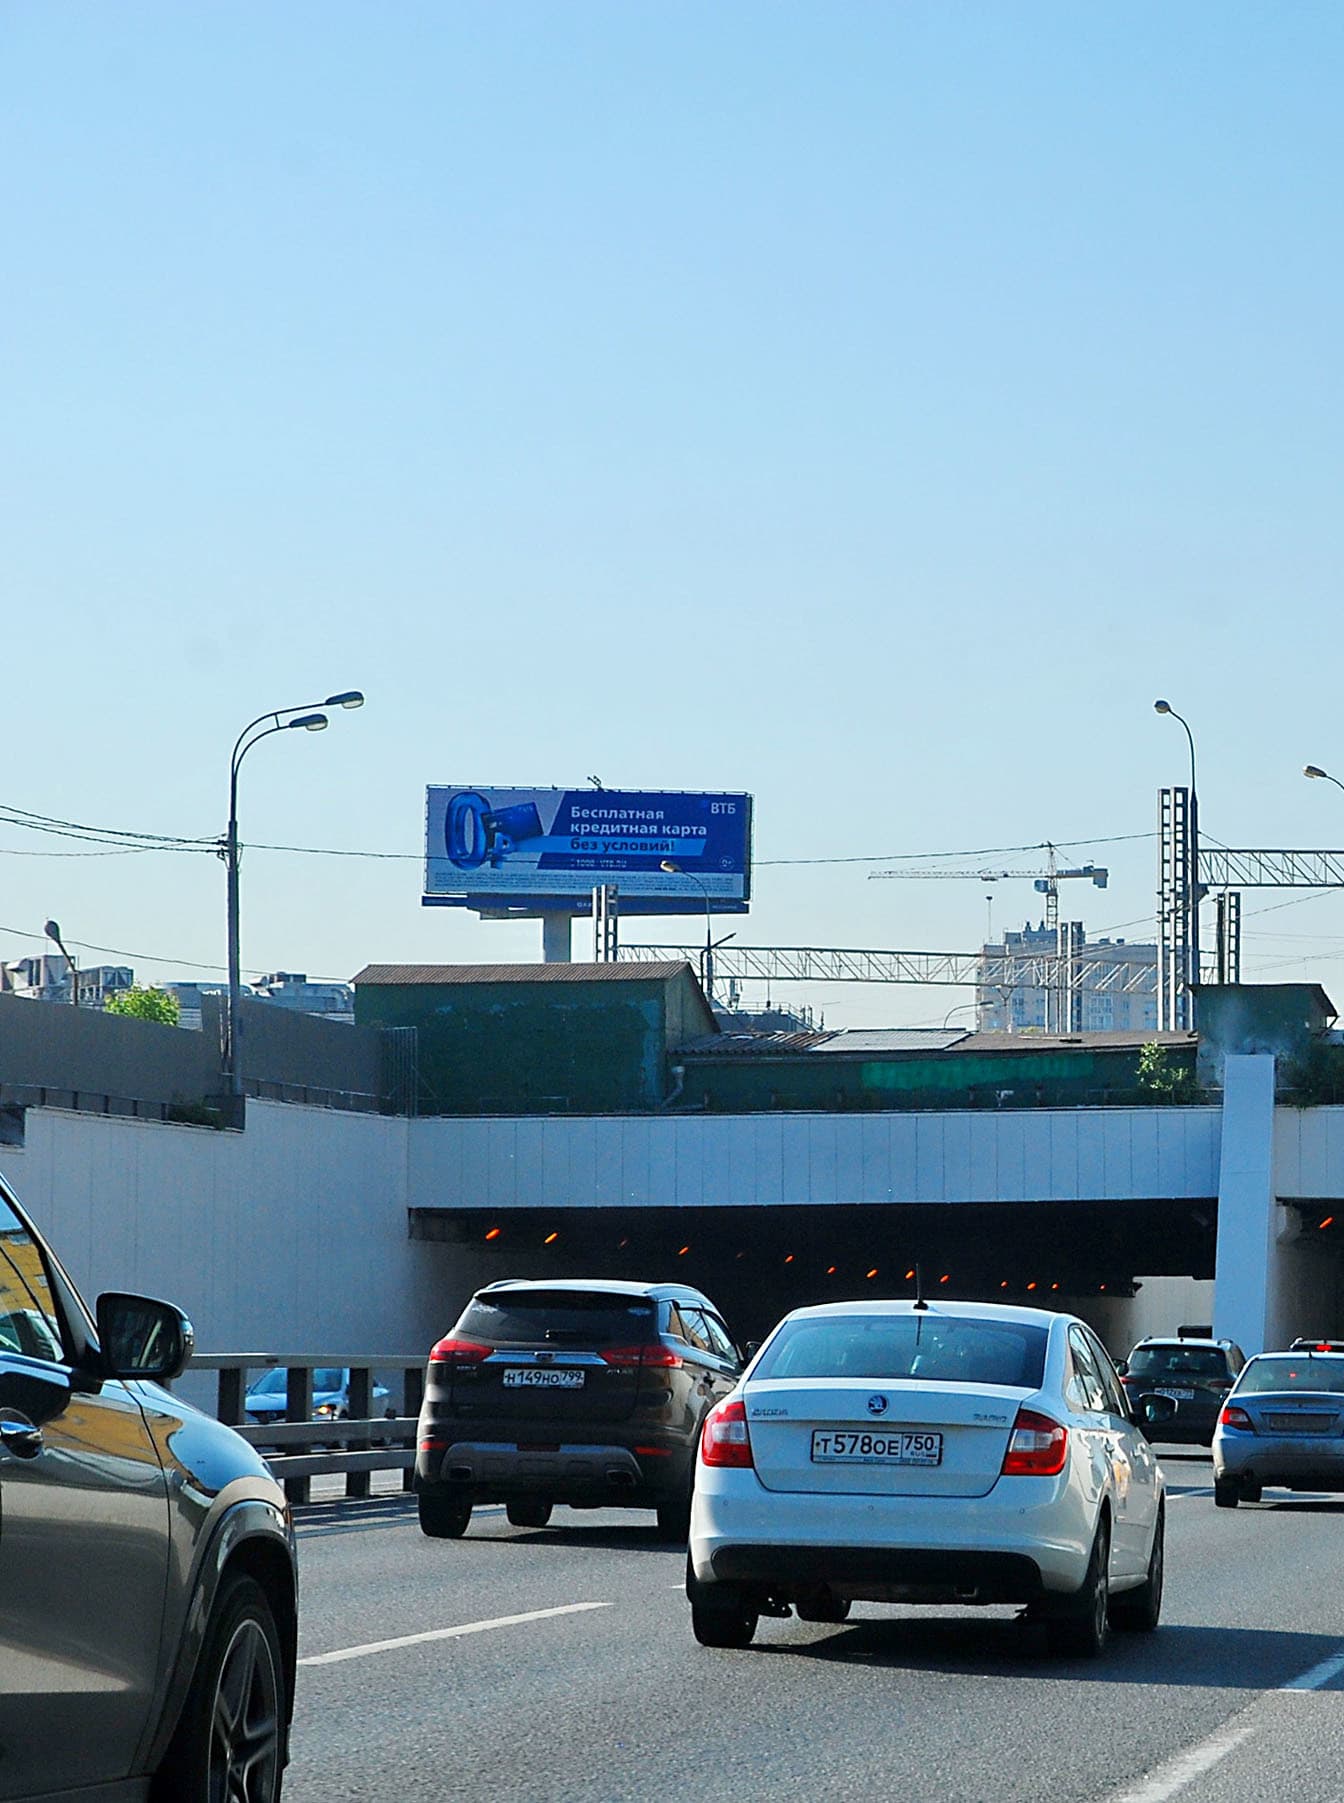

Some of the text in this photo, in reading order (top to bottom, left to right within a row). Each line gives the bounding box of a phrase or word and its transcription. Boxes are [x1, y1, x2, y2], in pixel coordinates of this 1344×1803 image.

[571, 806, 664, 819] Бесплатная
[711, 803, 736, 814] ВТБ
[571, 823, 707, 837] кредитная карта
[570, 838, 675, 853] без условий!
[904, 1435, 934, 1450] 750
